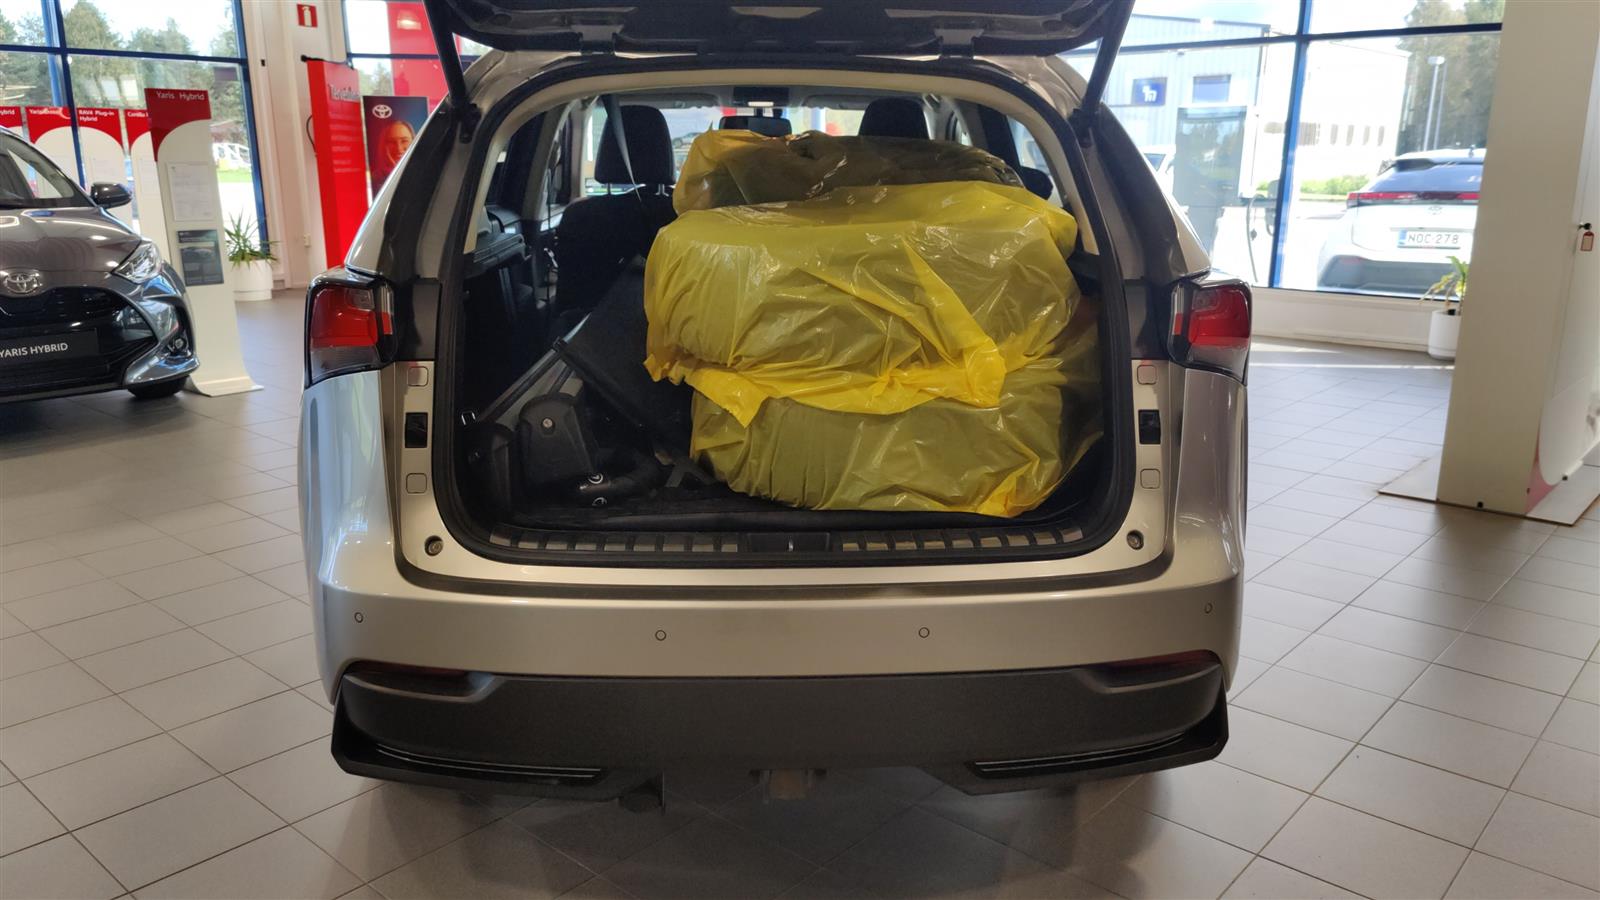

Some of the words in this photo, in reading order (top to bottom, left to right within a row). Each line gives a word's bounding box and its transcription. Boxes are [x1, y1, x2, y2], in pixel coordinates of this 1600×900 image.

[156, 91, 175, 99] Yaris
[179, 92, 204, 101] Hybrid
[0, 108, 15, 116] ybrid
[0, 346, 28, 358] YARIS
[30, 342, 69, 355] HYBRID
